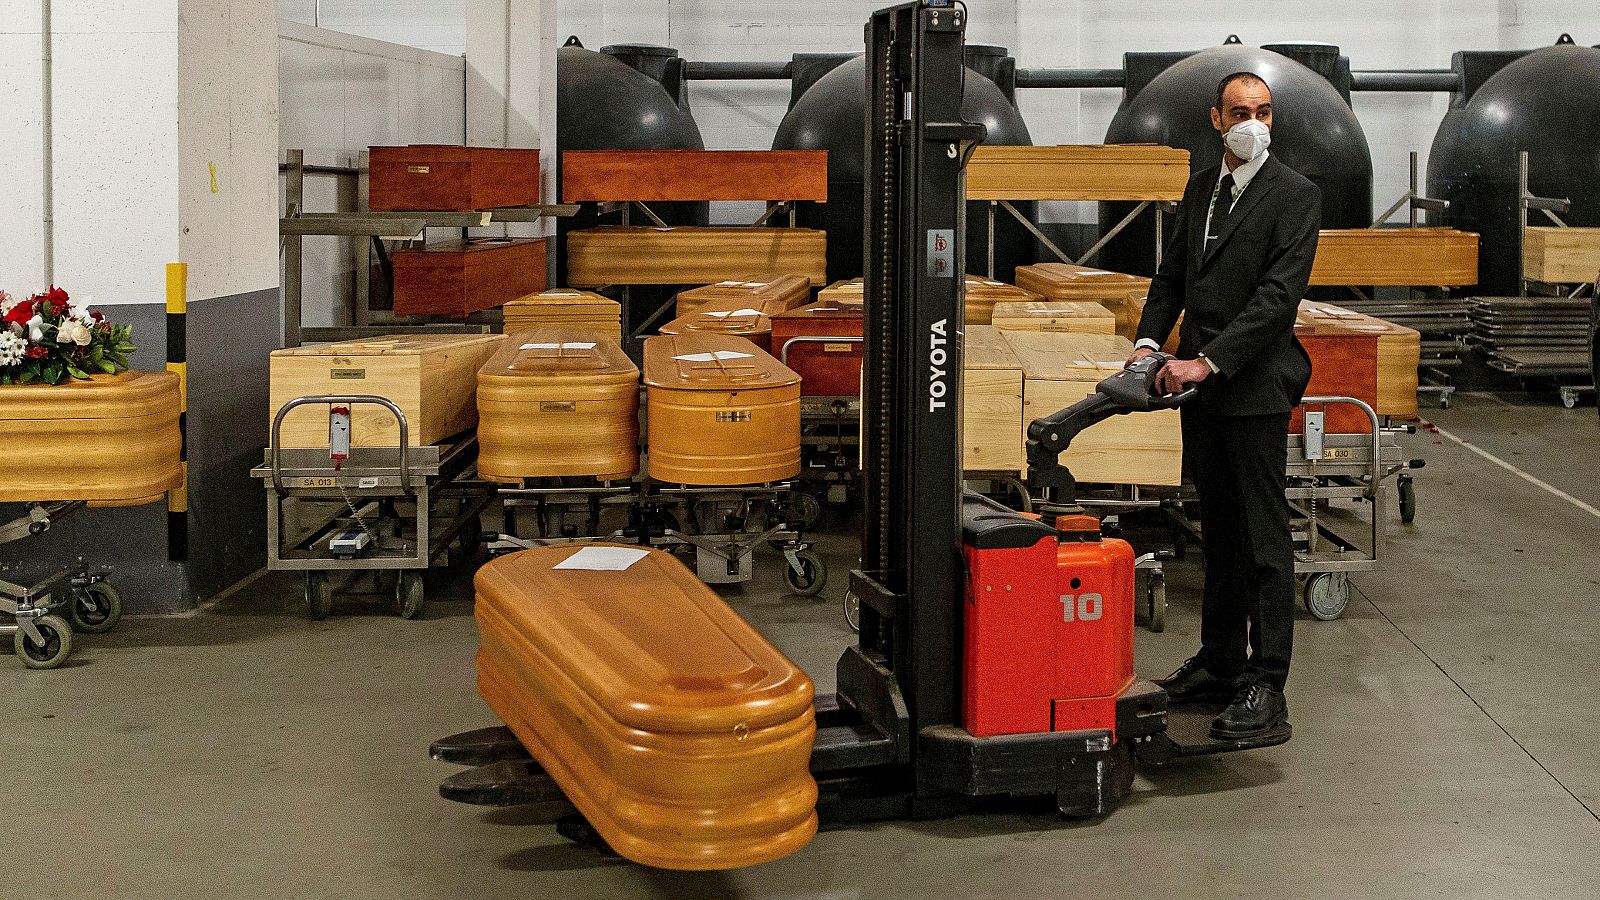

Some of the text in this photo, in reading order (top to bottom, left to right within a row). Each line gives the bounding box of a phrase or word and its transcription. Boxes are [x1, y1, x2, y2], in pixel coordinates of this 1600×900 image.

[929, 318, 947, 413] TOYOTA
[1323, 450, 1332, 458] SA
[1334, 450, 1349, 458] 030
[303, 478, 332, 486] SA 013
[1060, 592, 1103, 623] 10
